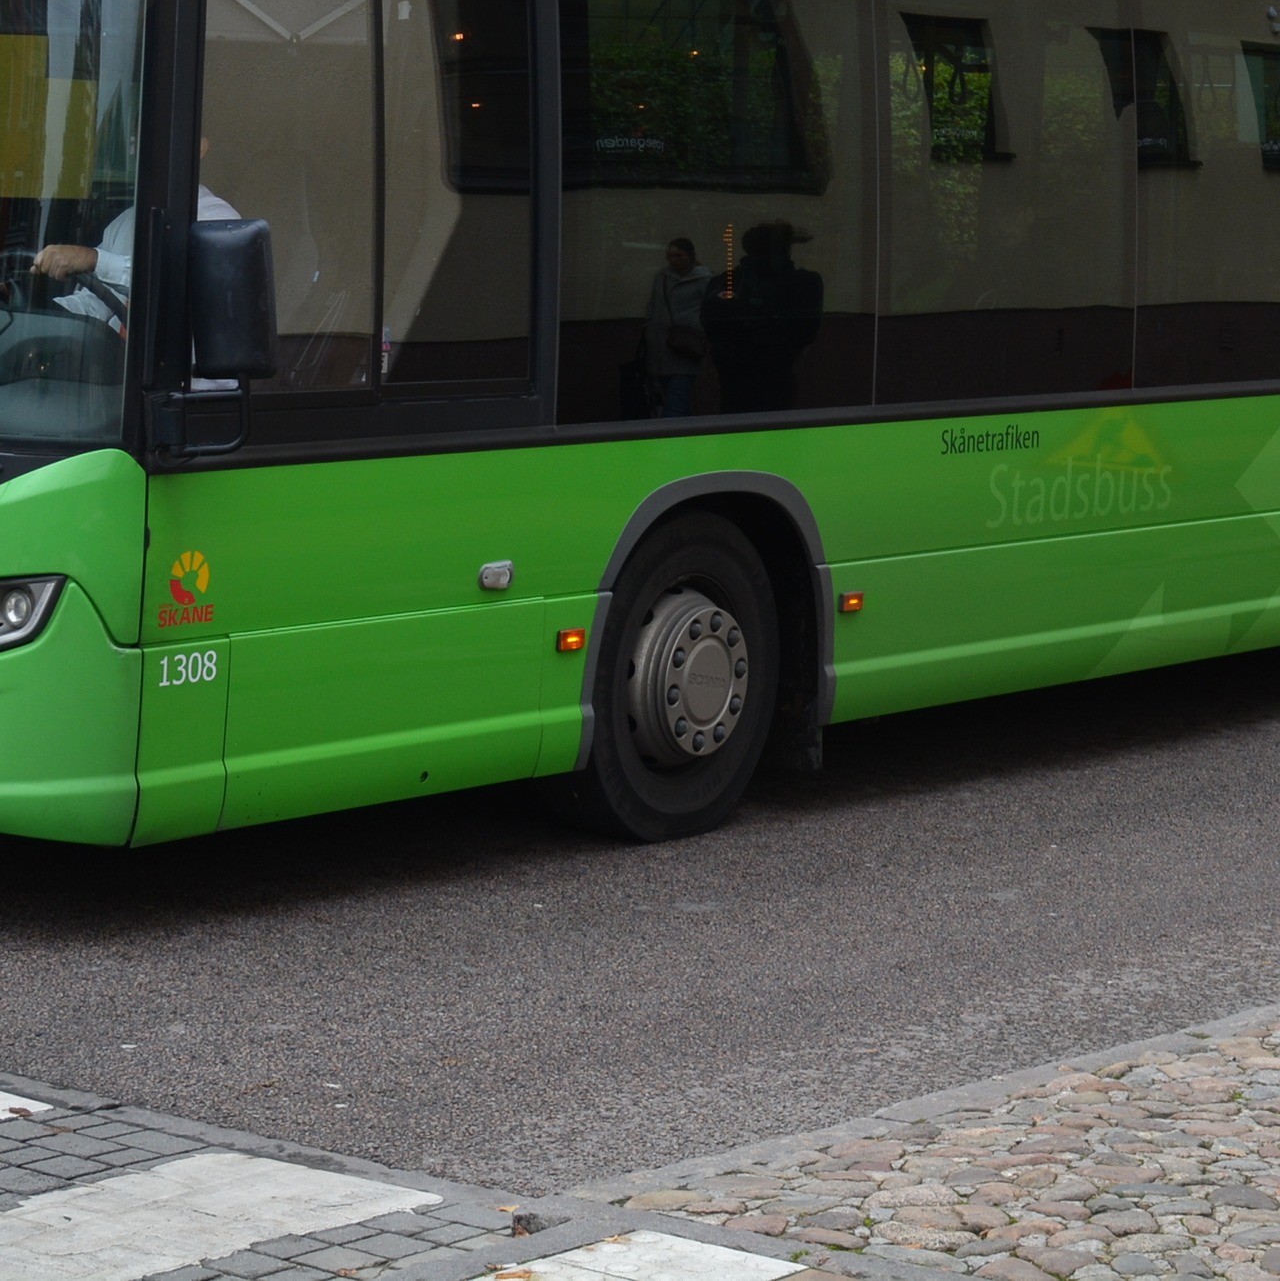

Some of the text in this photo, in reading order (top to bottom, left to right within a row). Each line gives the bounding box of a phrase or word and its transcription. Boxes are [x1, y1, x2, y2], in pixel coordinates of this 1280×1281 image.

[941, 425, 1040, 455] Skånetrafiken
[985, 453, 1173, 529] Stadsbuss
[159, 650, 218, 687] 1308
